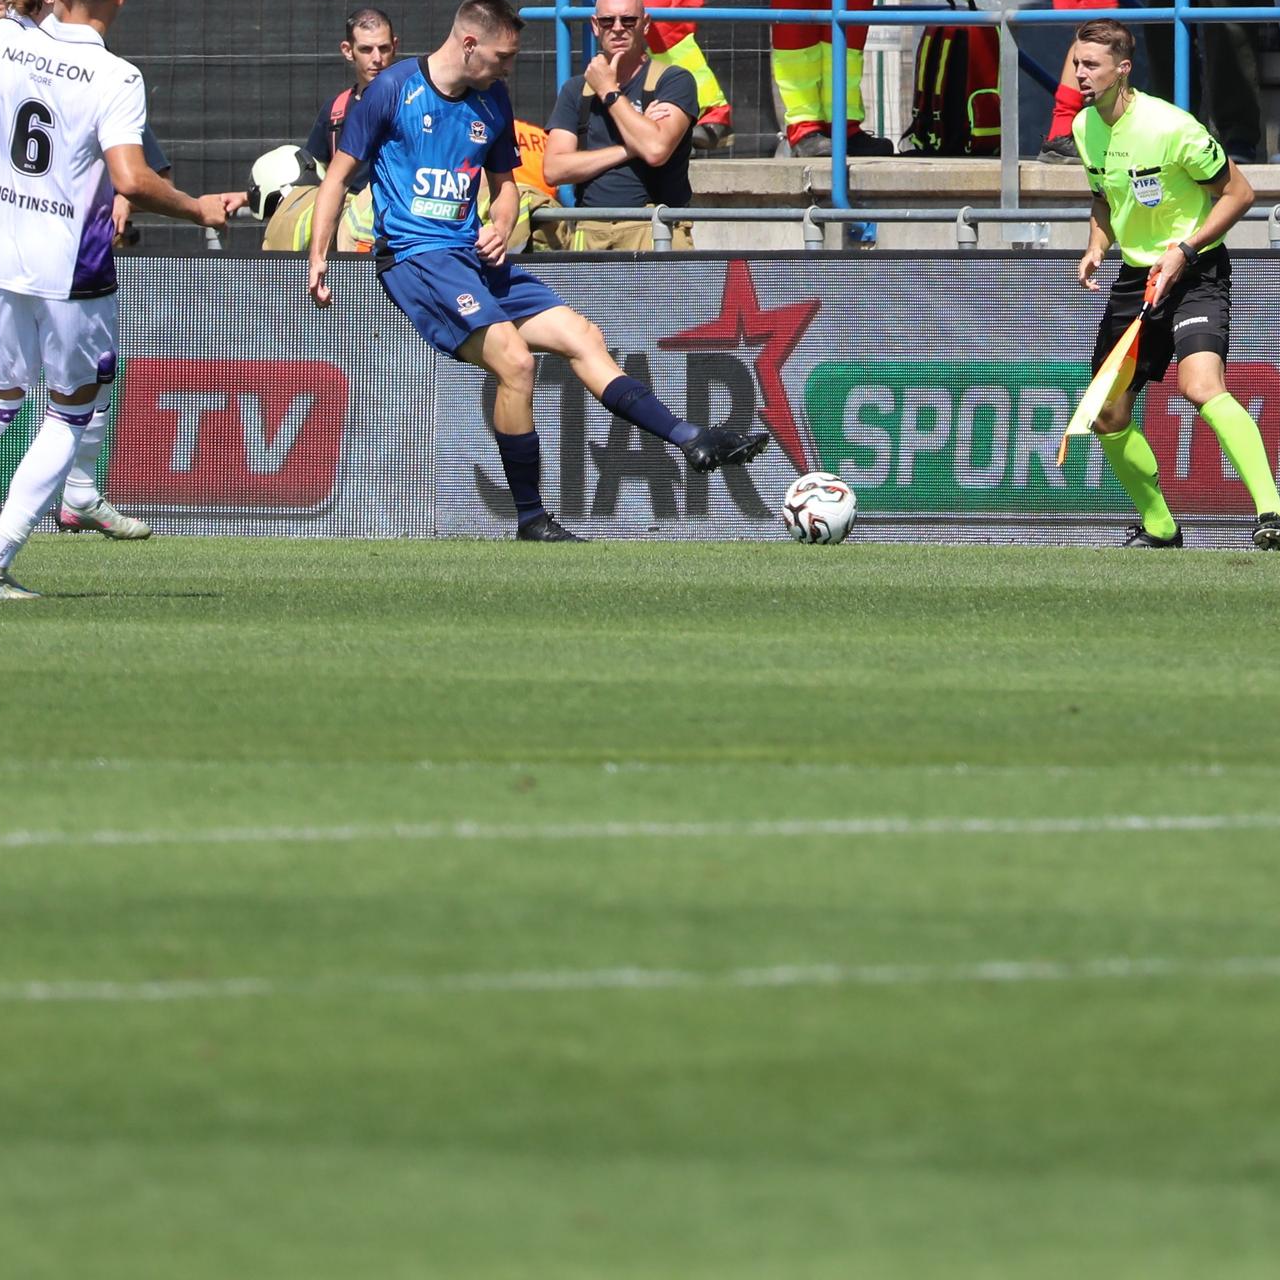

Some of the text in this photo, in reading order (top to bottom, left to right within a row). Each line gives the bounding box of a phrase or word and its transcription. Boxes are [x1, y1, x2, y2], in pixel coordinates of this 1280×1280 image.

[2, 46, 96, 84] NAPOLEON
[8, 97, 55, 177] 6
[412, 167, 472, 201] STAR
[1133, 178, 1157, 189] FIFA
[413, 200, 459, 217] SPORT
[157, 391, 318, 475] TV
